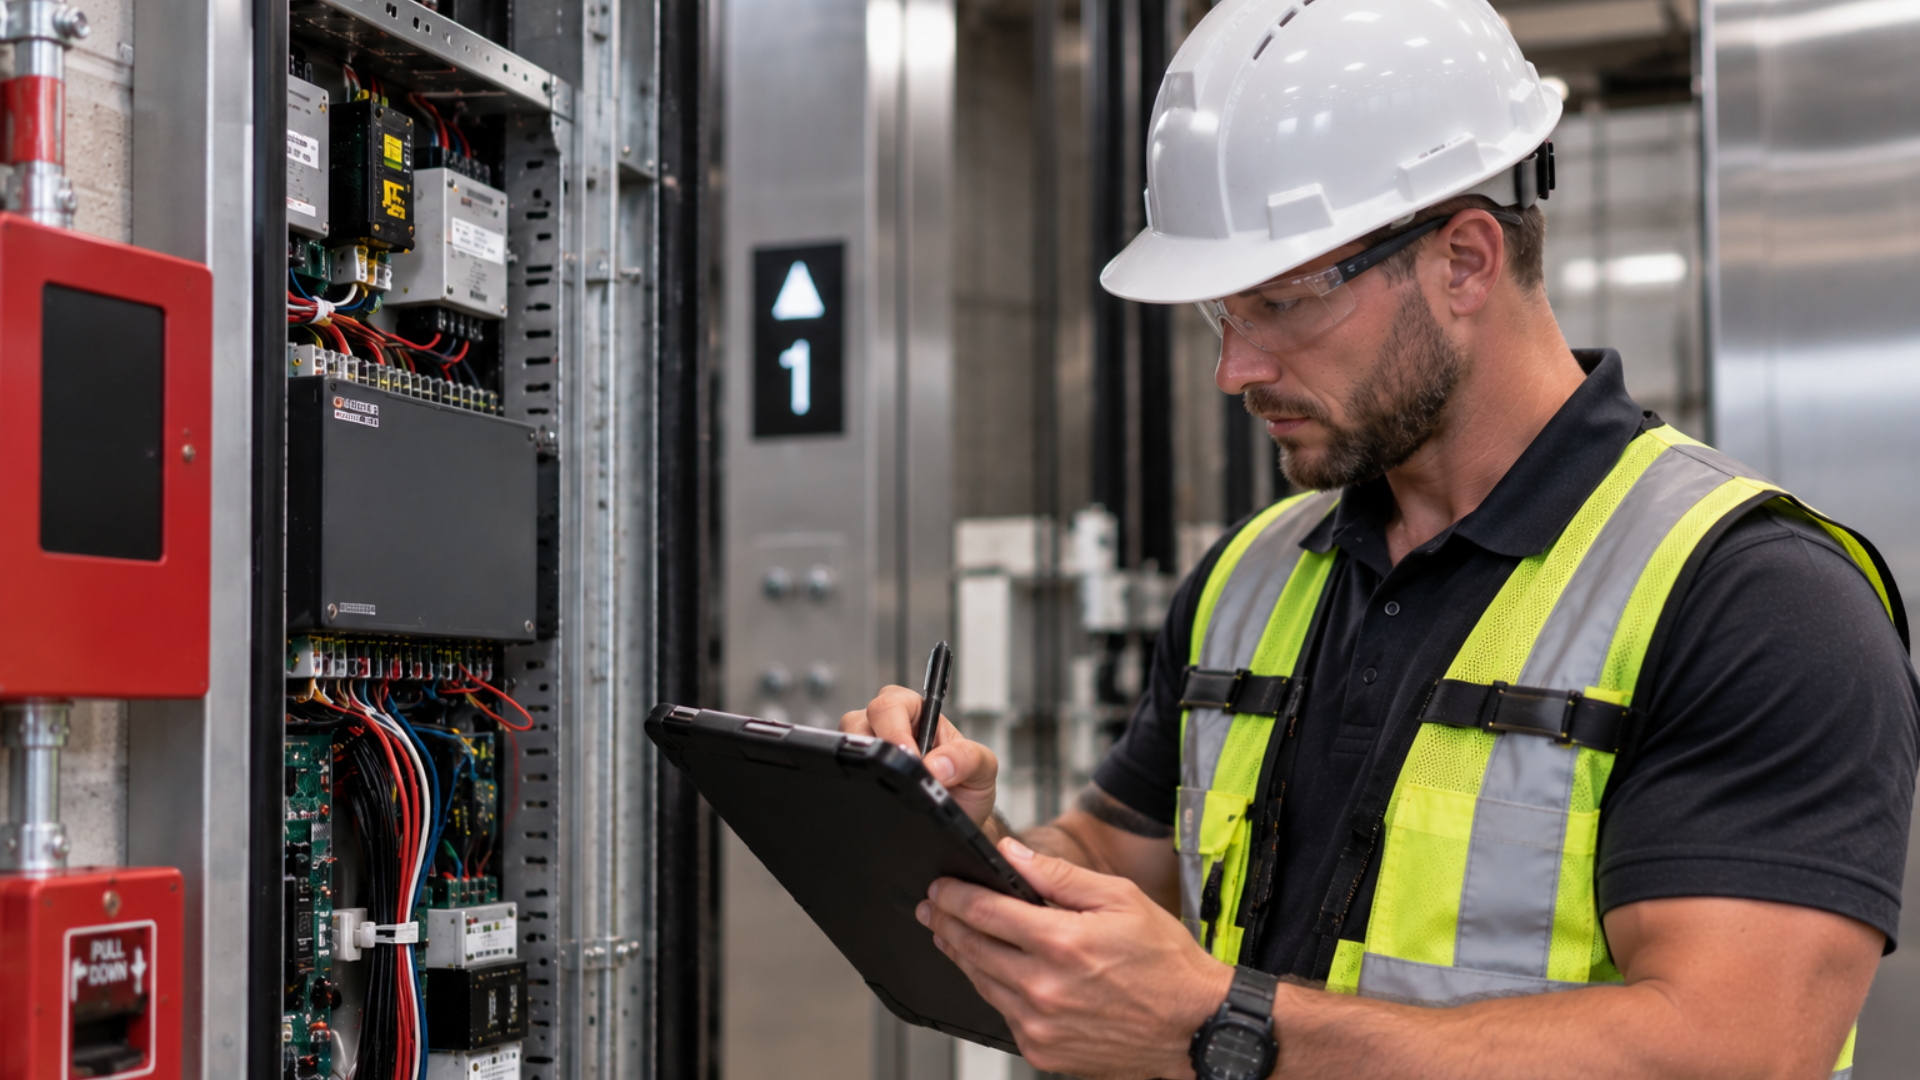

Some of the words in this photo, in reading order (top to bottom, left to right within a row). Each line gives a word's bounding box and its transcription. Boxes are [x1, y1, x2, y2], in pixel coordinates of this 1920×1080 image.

[779, 338, 810, 416] 1
[91, 938, 125, 962] PULL
[89, 961, 128, 986] DOWN
